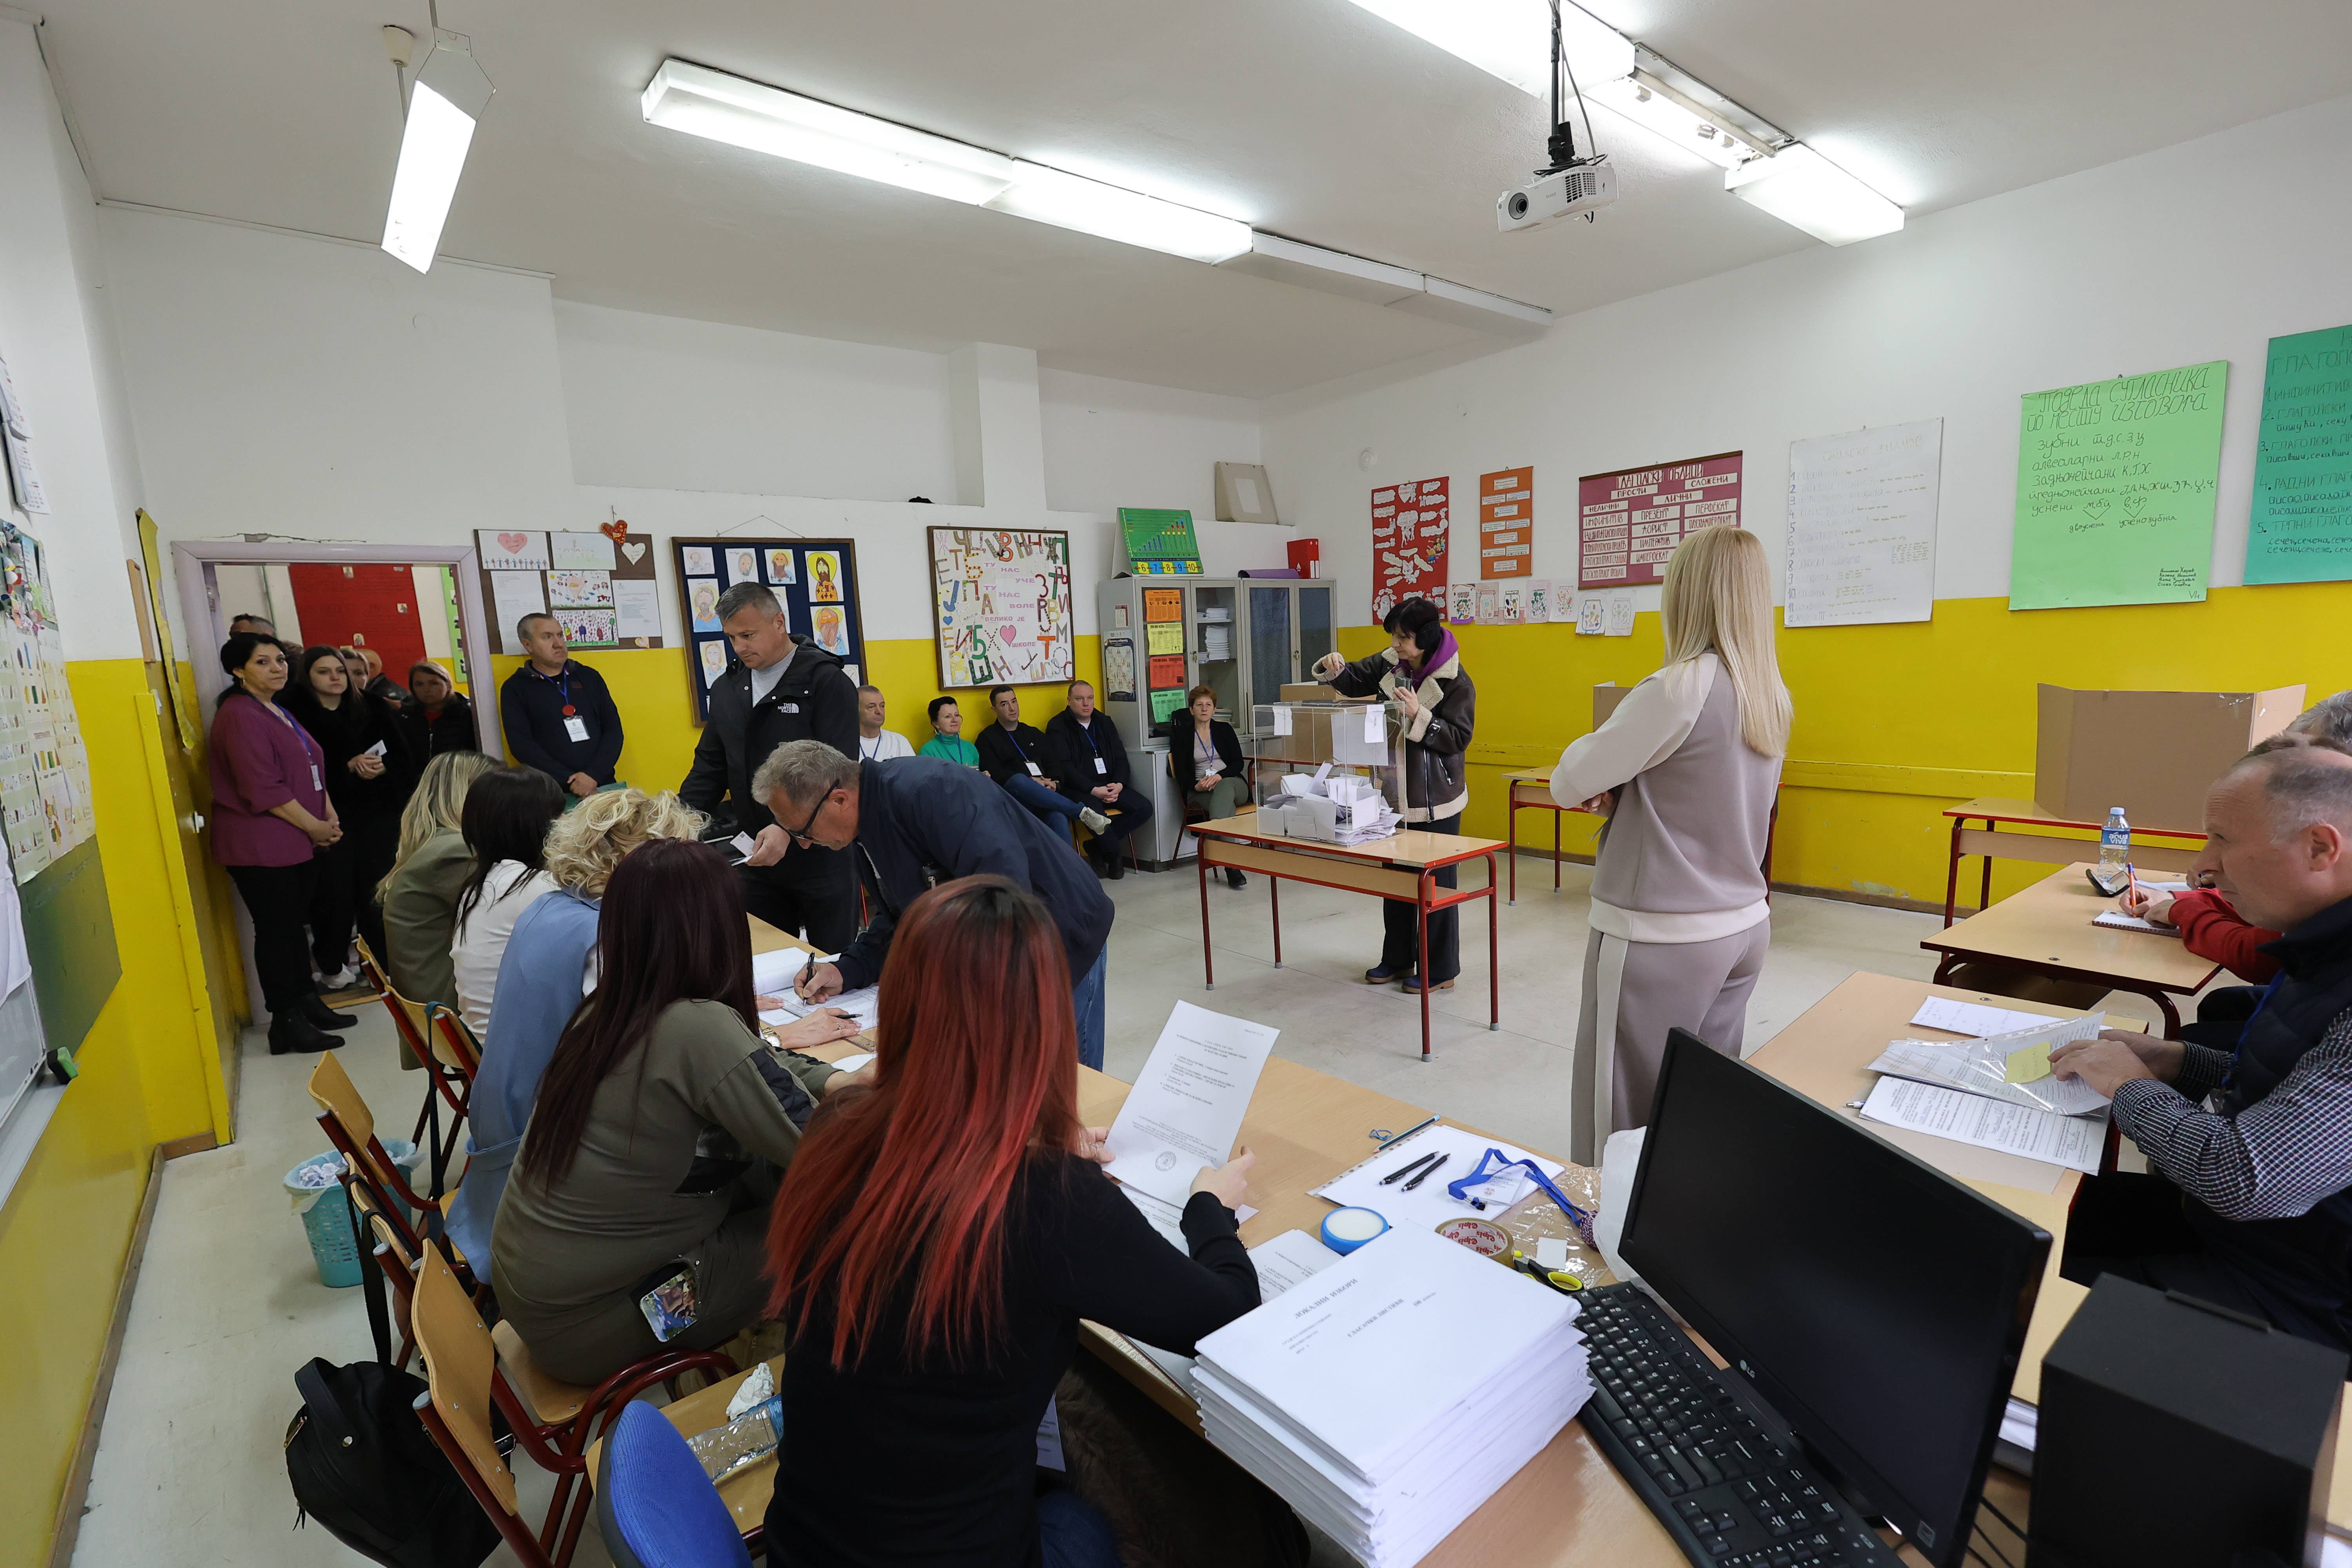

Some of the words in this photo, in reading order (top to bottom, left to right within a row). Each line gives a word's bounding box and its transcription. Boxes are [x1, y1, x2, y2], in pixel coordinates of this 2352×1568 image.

[1691, 475, 1728, 487] СЛОЖЕНИ
[1617, 488, 1646, 497] ПРОСТИ
[1789, 485, 1797, 494] 2
[1664, 493, 1692, 503] ЛИЧНИ
[1589, 503, 1619, 513] НЕЛИЧНИ
[1696, 501, 1729, 514] ПЕРФЕКАТ
[1641, 508, 1669, 520] ПРЕЗЕНТ
[1586, 514, 1623, 526] ИНФИНИТИВ
[1642, 523, 1668, 534] АОРИСТ
[1790, 523, 1796, 534] 5
[1640, 537, 1670, 548] ИМПЕРАТИВ
[1636, 551, 1669, 563] ИМПЕРФЕКАТ
[963, 552, 983, 579] Б
[982, 593, 993, 615] А
[1294, 1296, 1330, 1319] ЛОКАЛНИ
[1330, 1278, 1358, 1297] ИЗБОРИ
[1747, 1367, 1755, 1378] LG
